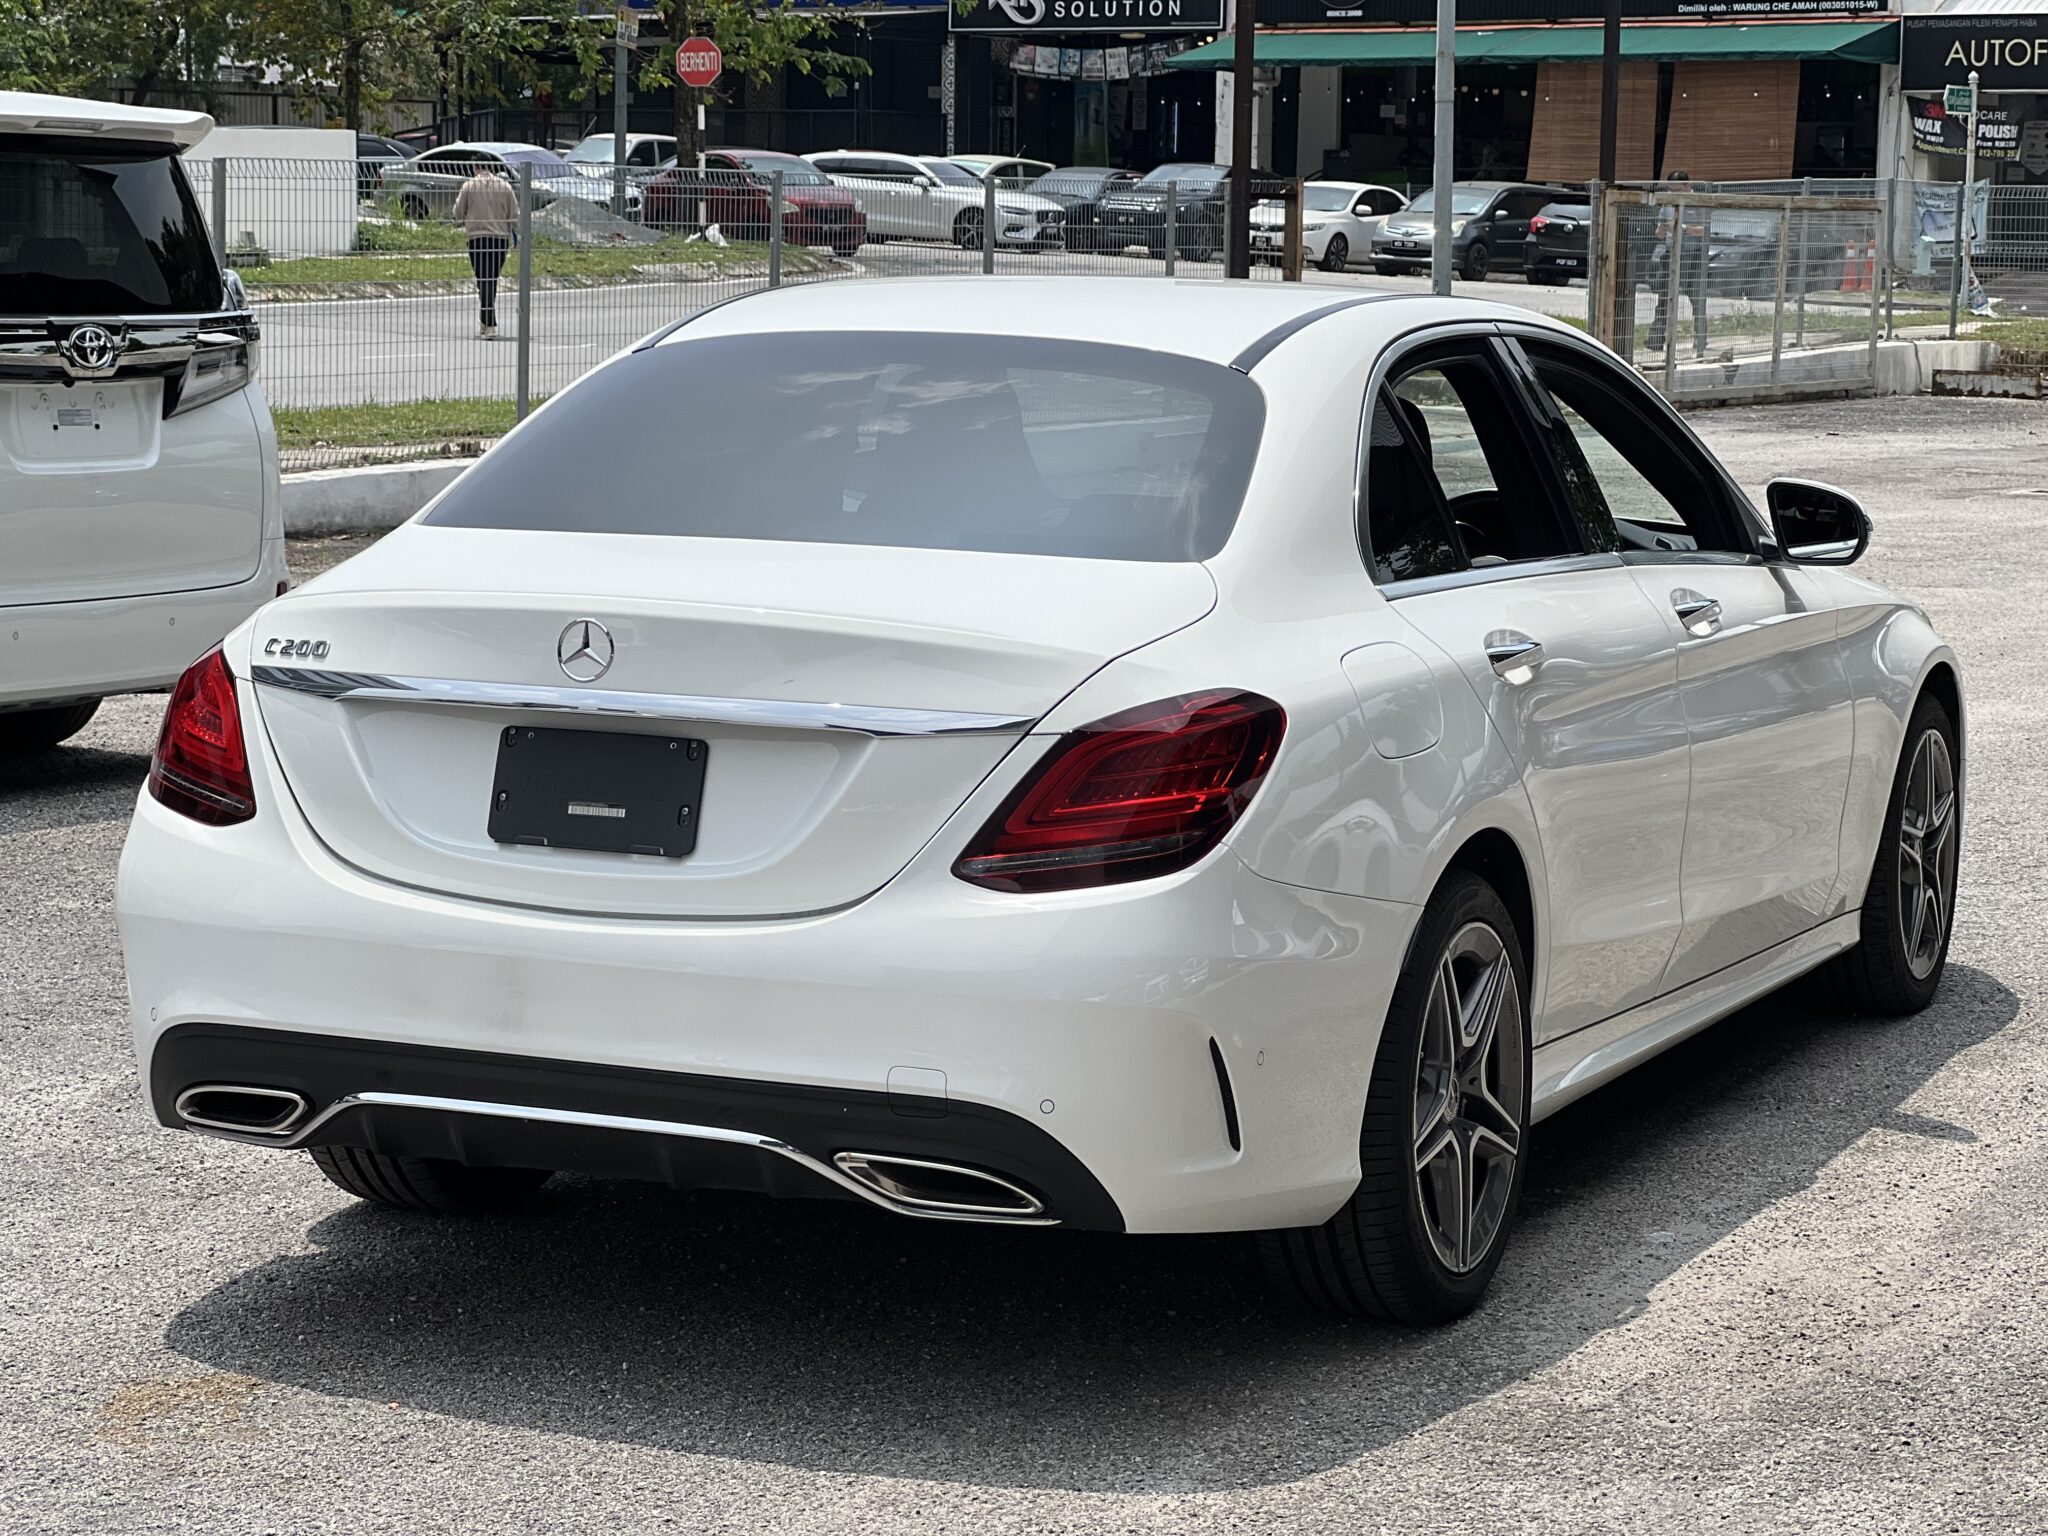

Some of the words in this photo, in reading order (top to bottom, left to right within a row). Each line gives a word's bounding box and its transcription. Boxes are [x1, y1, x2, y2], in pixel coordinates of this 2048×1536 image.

[1053, 0, 1181, 18] SOLUTION
[1678, 4, 1708, 13] Dimiliki
[1708, 4, 1727, 12] oleh
[1732, 3, 1771, 11] WARUNG
[1772, 2, 1791, 10] CHE
[1791, 2, 1818, 10] AMAH
[1906, 20, 1927, 28] PUSAT
[680, 51, 718, 72] BERHENTI
[1913, 117, 1942, 134] WAX
[1977, 124, 2019, 139] POLISH
